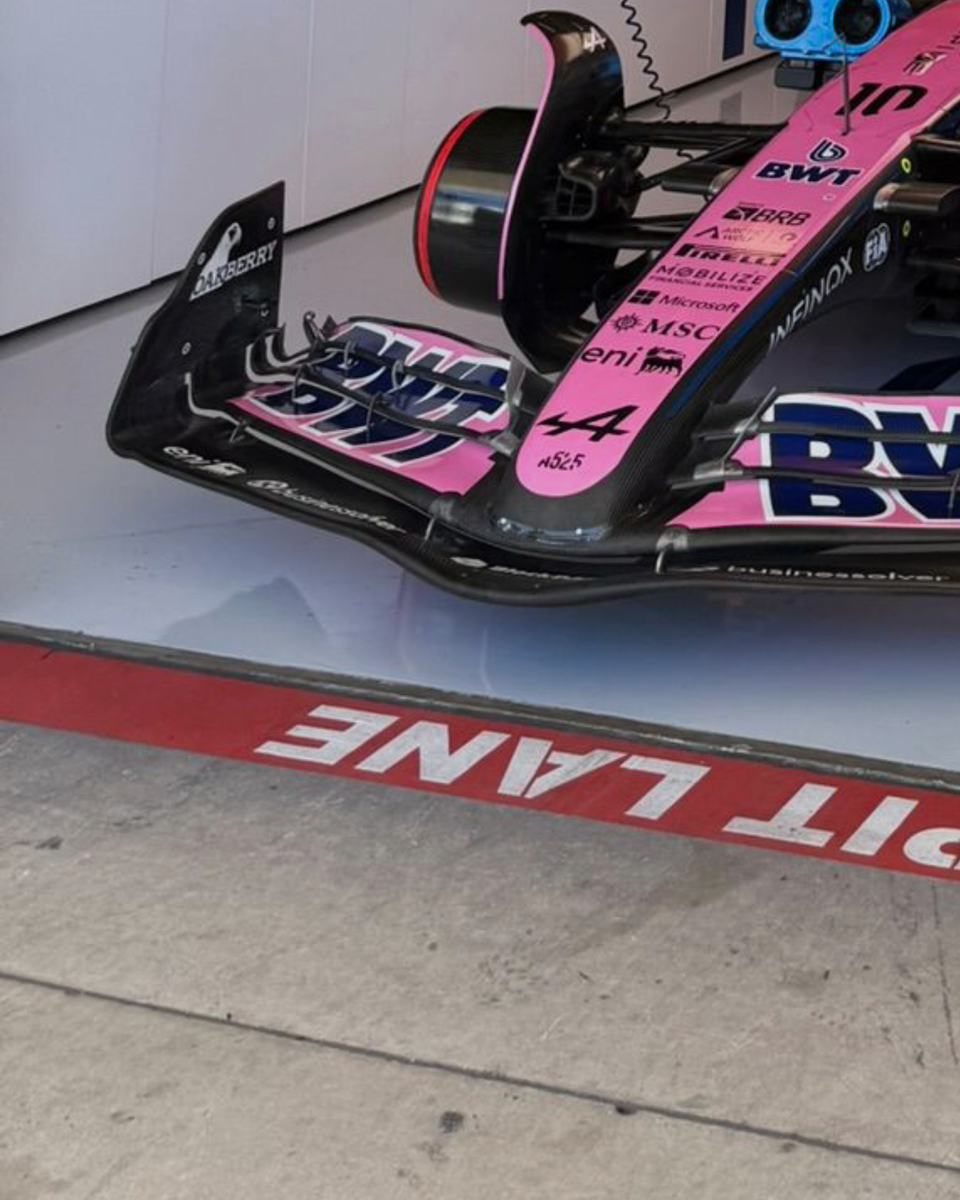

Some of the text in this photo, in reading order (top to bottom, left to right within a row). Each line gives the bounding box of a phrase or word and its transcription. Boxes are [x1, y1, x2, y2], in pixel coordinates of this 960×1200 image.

[835, 82, 928, 116] 10
[754, 161, 864, 187] BWT
[751, 209, 811, 226] BRB
[674, 243, 786, 267] PIRELLI
[865, 231, 888, 267] FIA
[194, 239, 278, 297] OAKBERRY
[659, 294, 741, 314] Microsoft
[769, 247, 853, 353] INFINOX
[641, 318, 720, 341] MSC
[581, 346, 643, 368] eni
[254, 704, 711, 821] LANE
